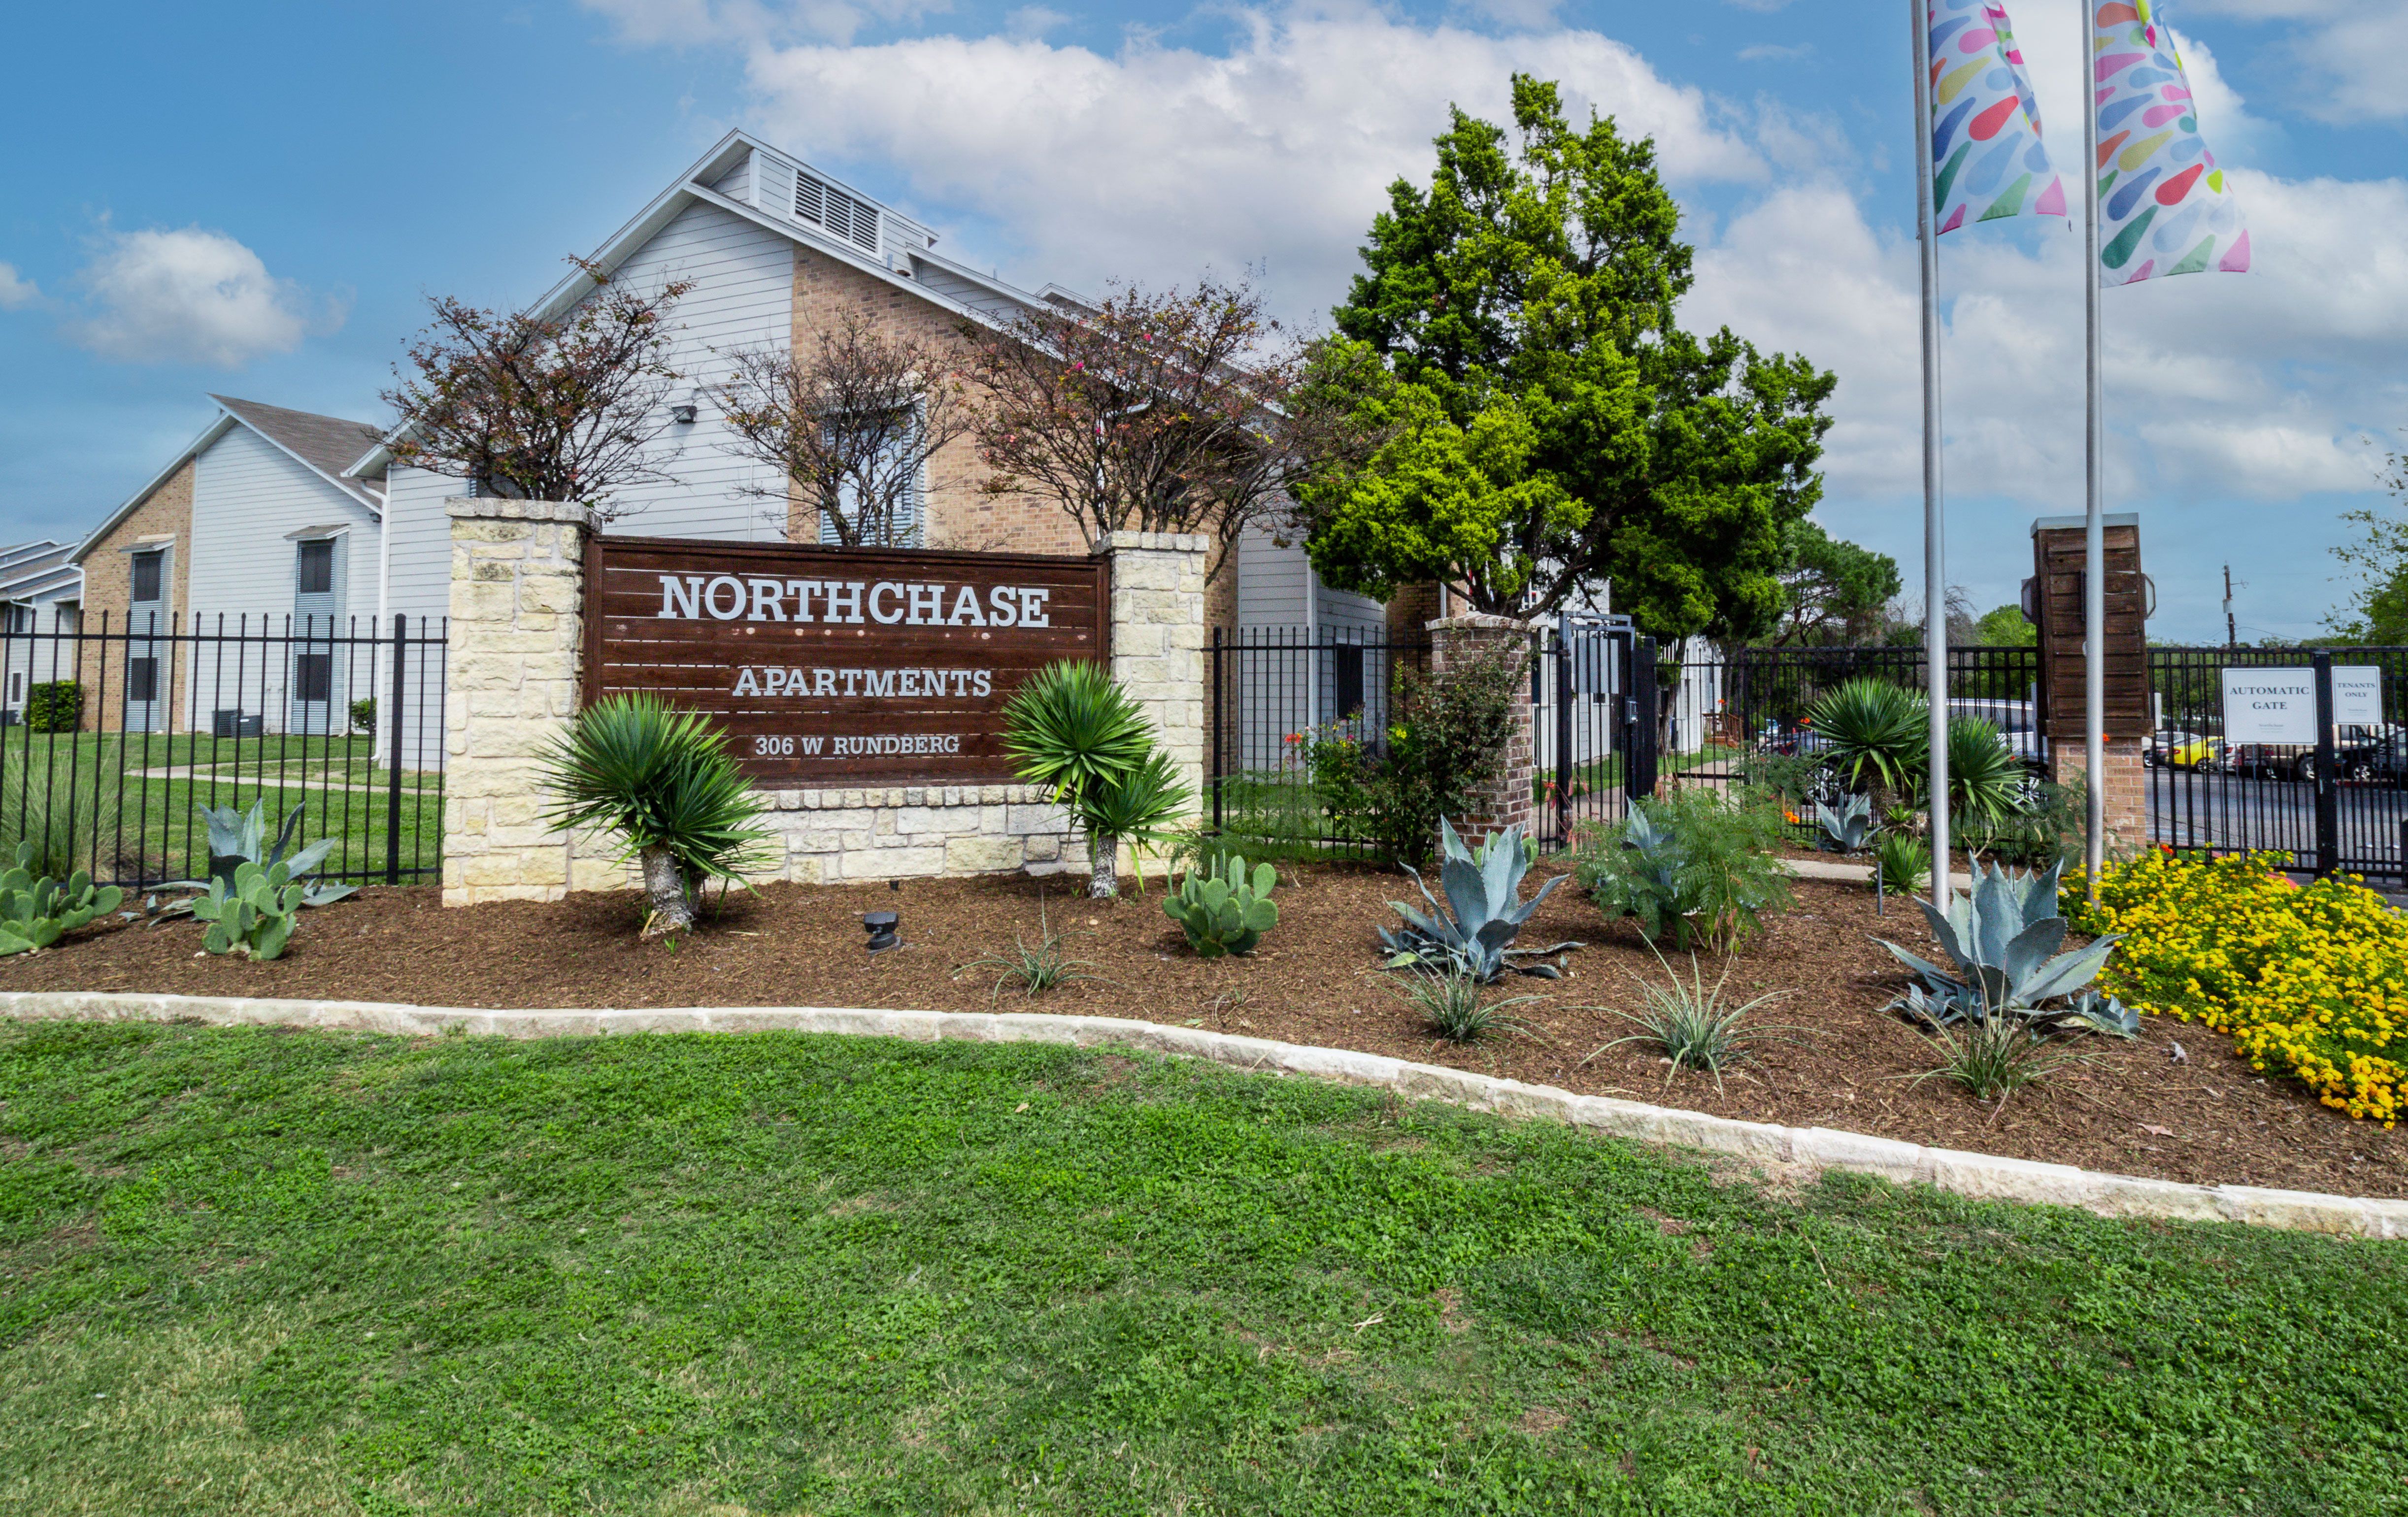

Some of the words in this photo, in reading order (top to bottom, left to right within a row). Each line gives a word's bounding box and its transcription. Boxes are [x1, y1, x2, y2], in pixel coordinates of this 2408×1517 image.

[658, 575, 1050, 628] NORTHCHASE
[732, 668, 992, 697] APARTMENTS
[2230, 687, 2309, 695] AUTOMATIC
[2252, 701, 2287, 710] GATE
[755, 737, 794, 756] 306
[803, 737, 824, 755] W
[833, 735, 960, 755] RUNDBERG
